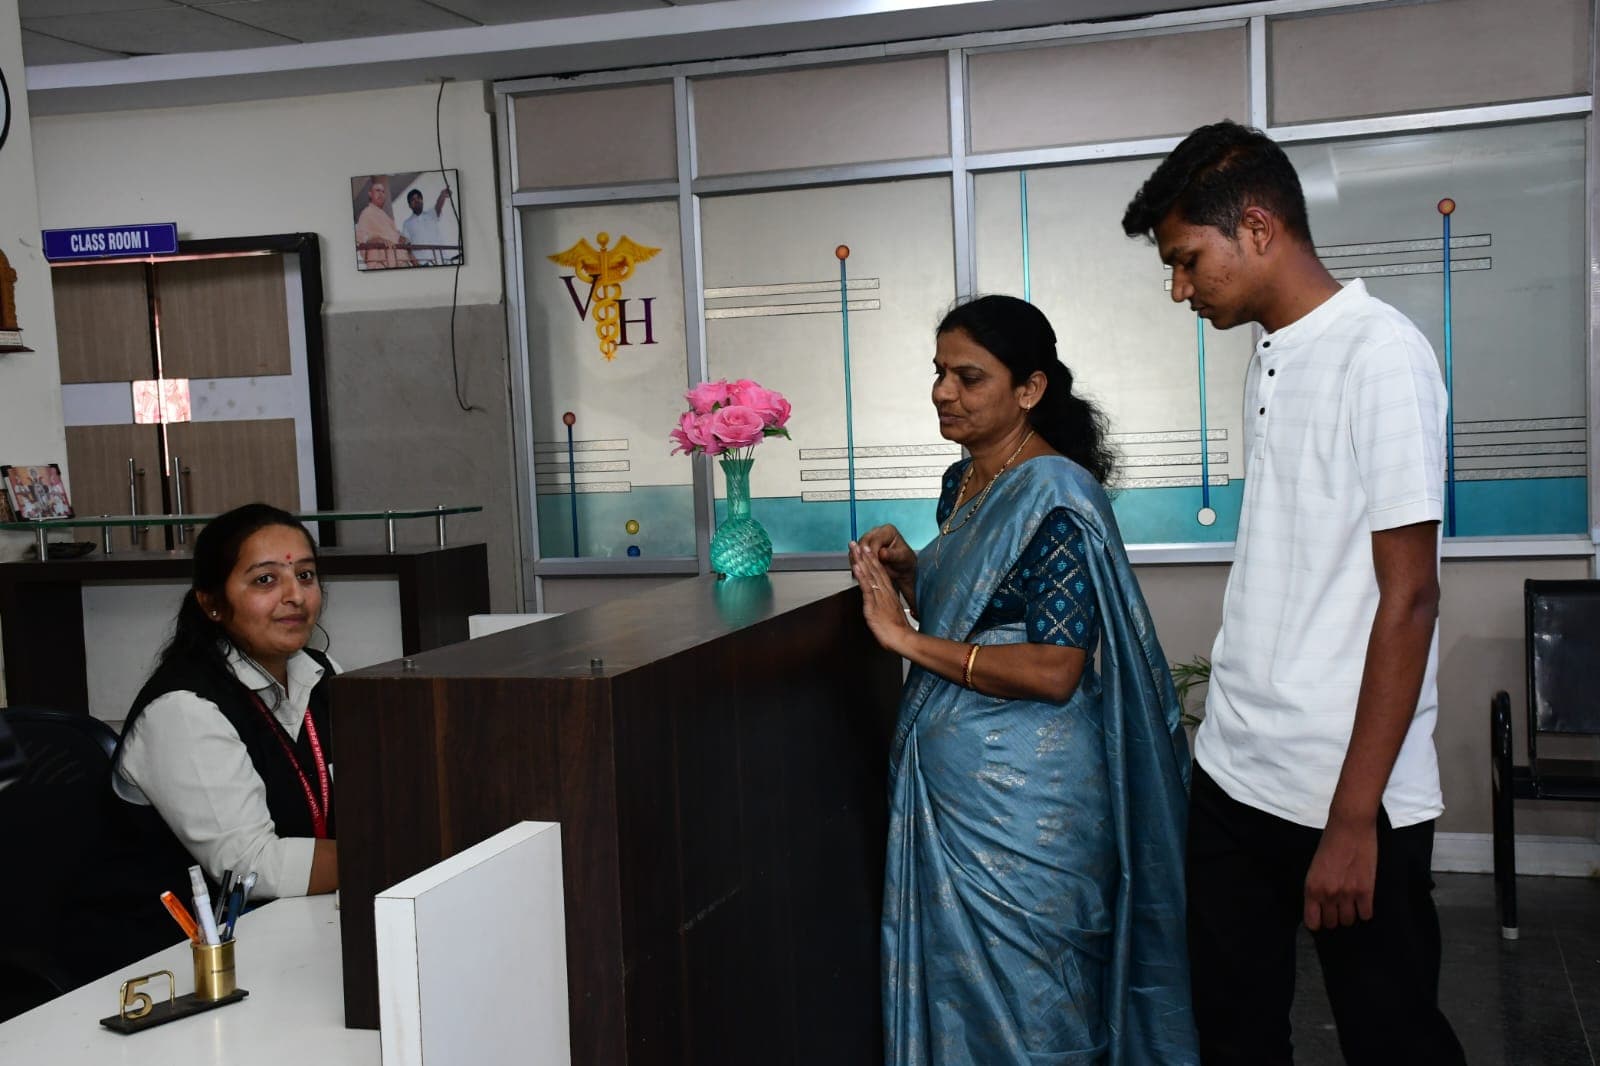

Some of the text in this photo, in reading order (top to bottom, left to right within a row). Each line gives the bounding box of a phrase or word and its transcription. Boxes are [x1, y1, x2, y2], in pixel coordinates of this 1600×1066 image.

[71, 230, 149, 252] CLASS ROOM I
[124, 978, 153, 1020] 5
